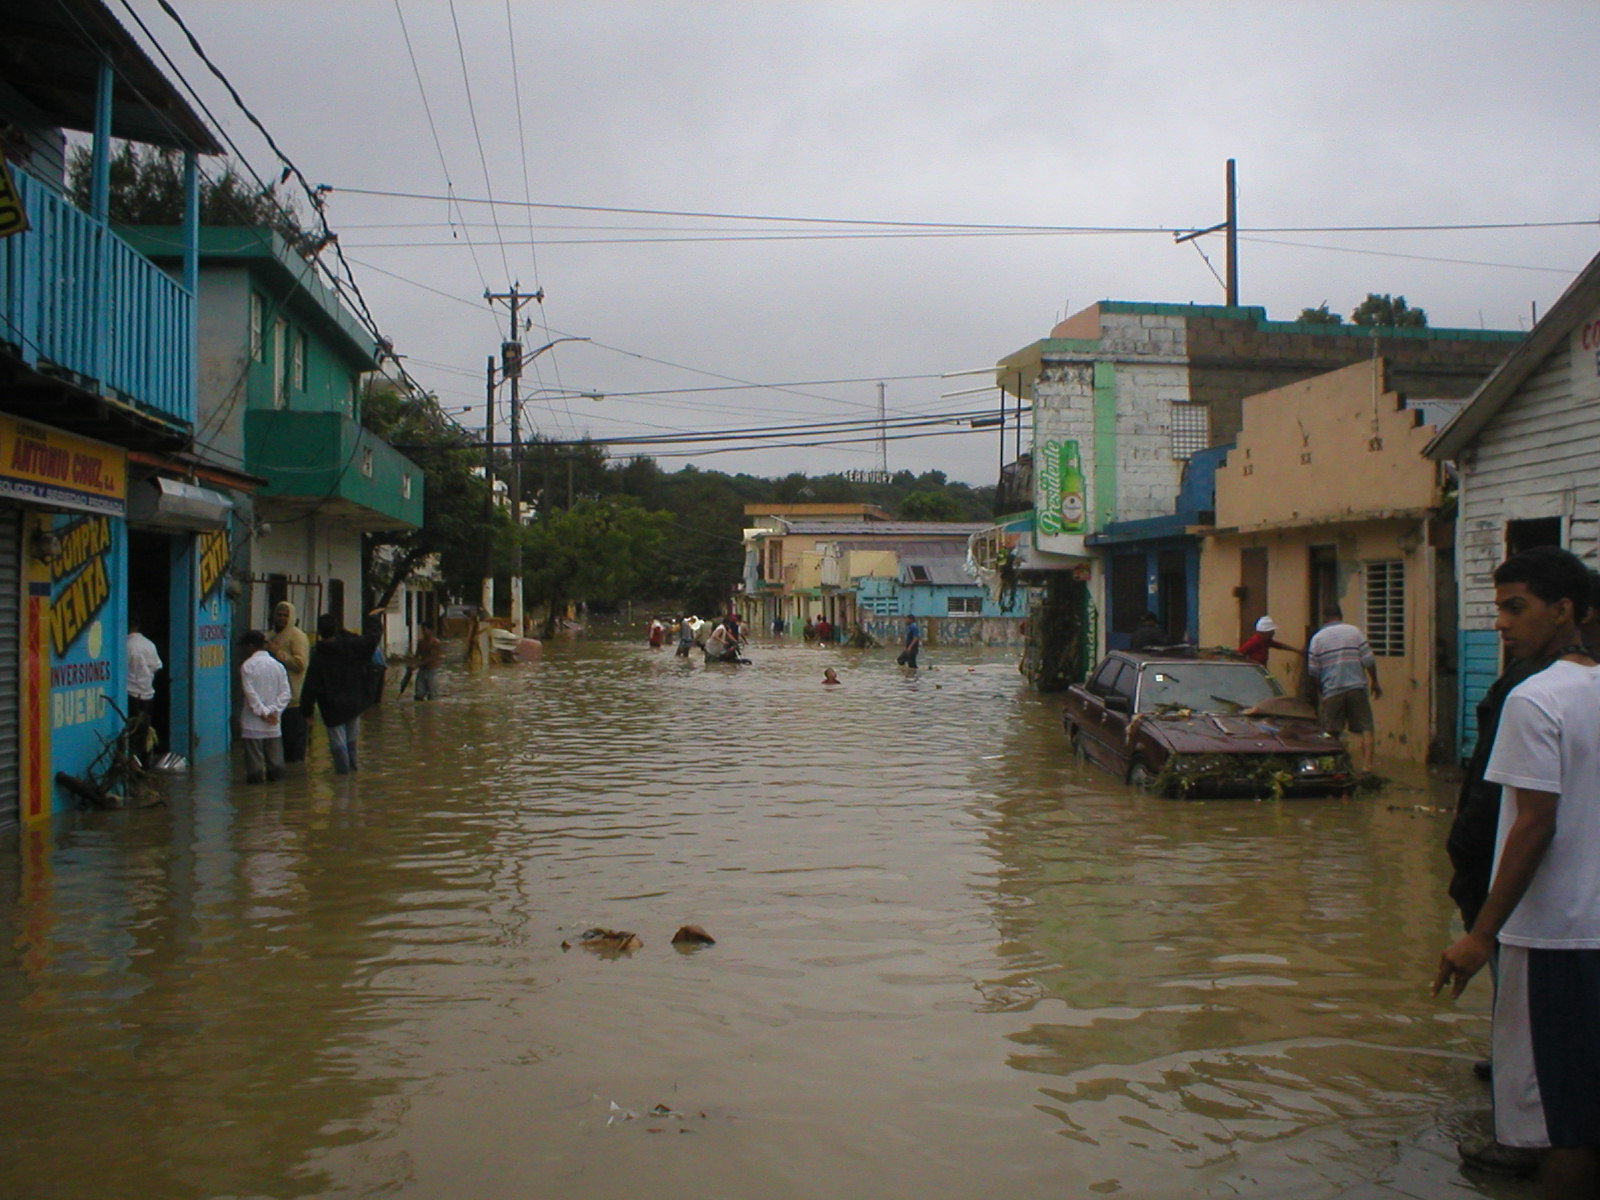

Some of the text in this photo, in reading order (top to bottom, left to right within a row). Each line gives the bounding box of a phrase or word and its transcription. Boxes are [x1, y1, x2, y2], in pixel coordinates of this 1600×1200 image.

[11, 437, 69, 481] ANTONIO
[1040, 440, 1060, 532] Presidente
[200, 530, 229, 600] ENTA
[50, 554, 109, 657] VENTA
[50, 660, 111, 688] INVERSIONES
[53, 686, 106, 728] BUENO
